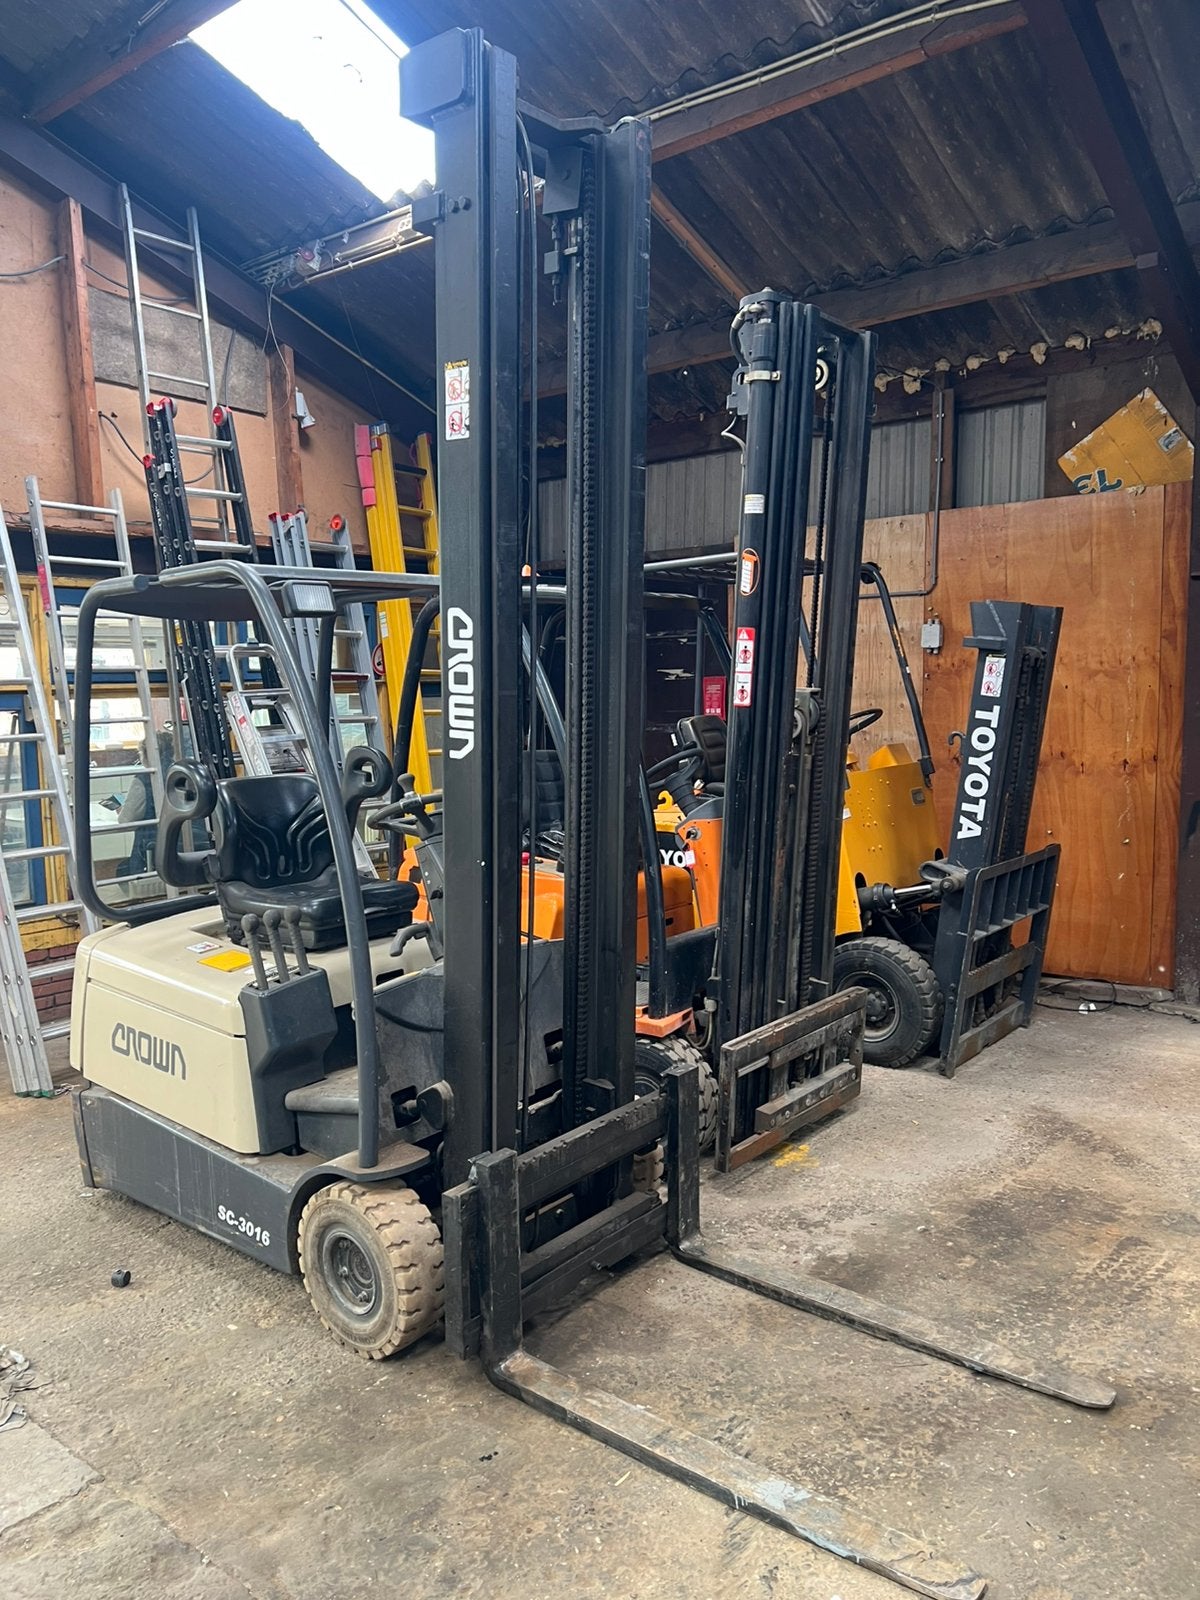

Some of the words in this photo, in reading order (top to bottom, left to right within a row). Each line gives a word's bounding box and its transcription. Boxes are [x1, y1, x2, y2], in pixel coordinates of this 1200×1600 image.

[447, 607, 475, 760] CROWN
[956, 705, 1001, 840] TOYOTA
[658, 848, 687, 868] YO
[111, 1022, 187, 1081] CROWN
[217, 1204, 271, 1247] SC-3016
